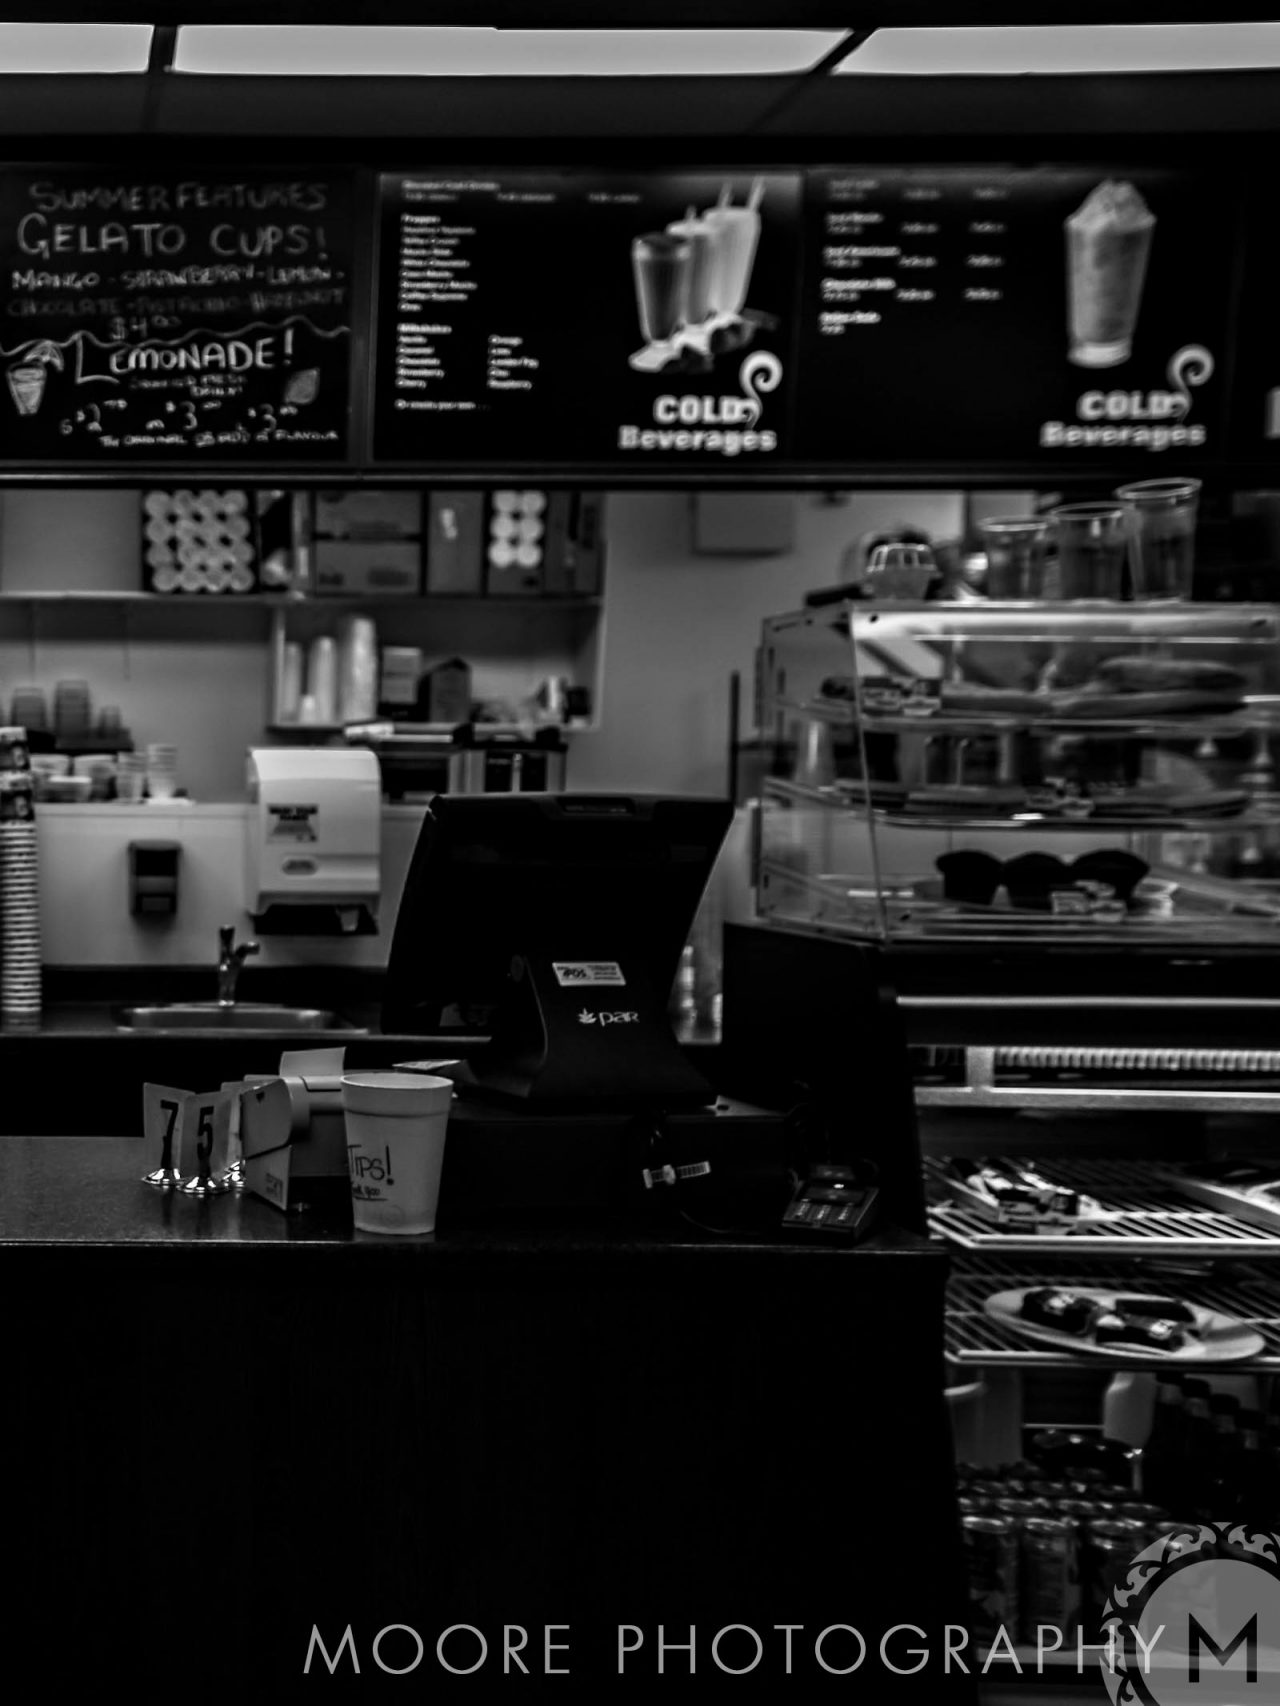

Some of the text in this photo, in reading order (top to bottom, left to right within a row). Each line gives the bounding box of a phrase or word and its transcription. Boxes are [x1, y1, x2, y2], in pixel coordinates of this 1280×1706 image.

[28, 180, 170, 213] SUMMER
[17, 211, 329, 262] GELATO CUPS!
[75, 325, 295, 386] LEMONADE!
[653, 394, 751, 425] COLD
[1076, 389, 1183, 420] COLD
[619, 424, 778, 457] Beverages
[1039, 421, 1207, 452] Beverages
[197, 1106, 214, 1161] 5
